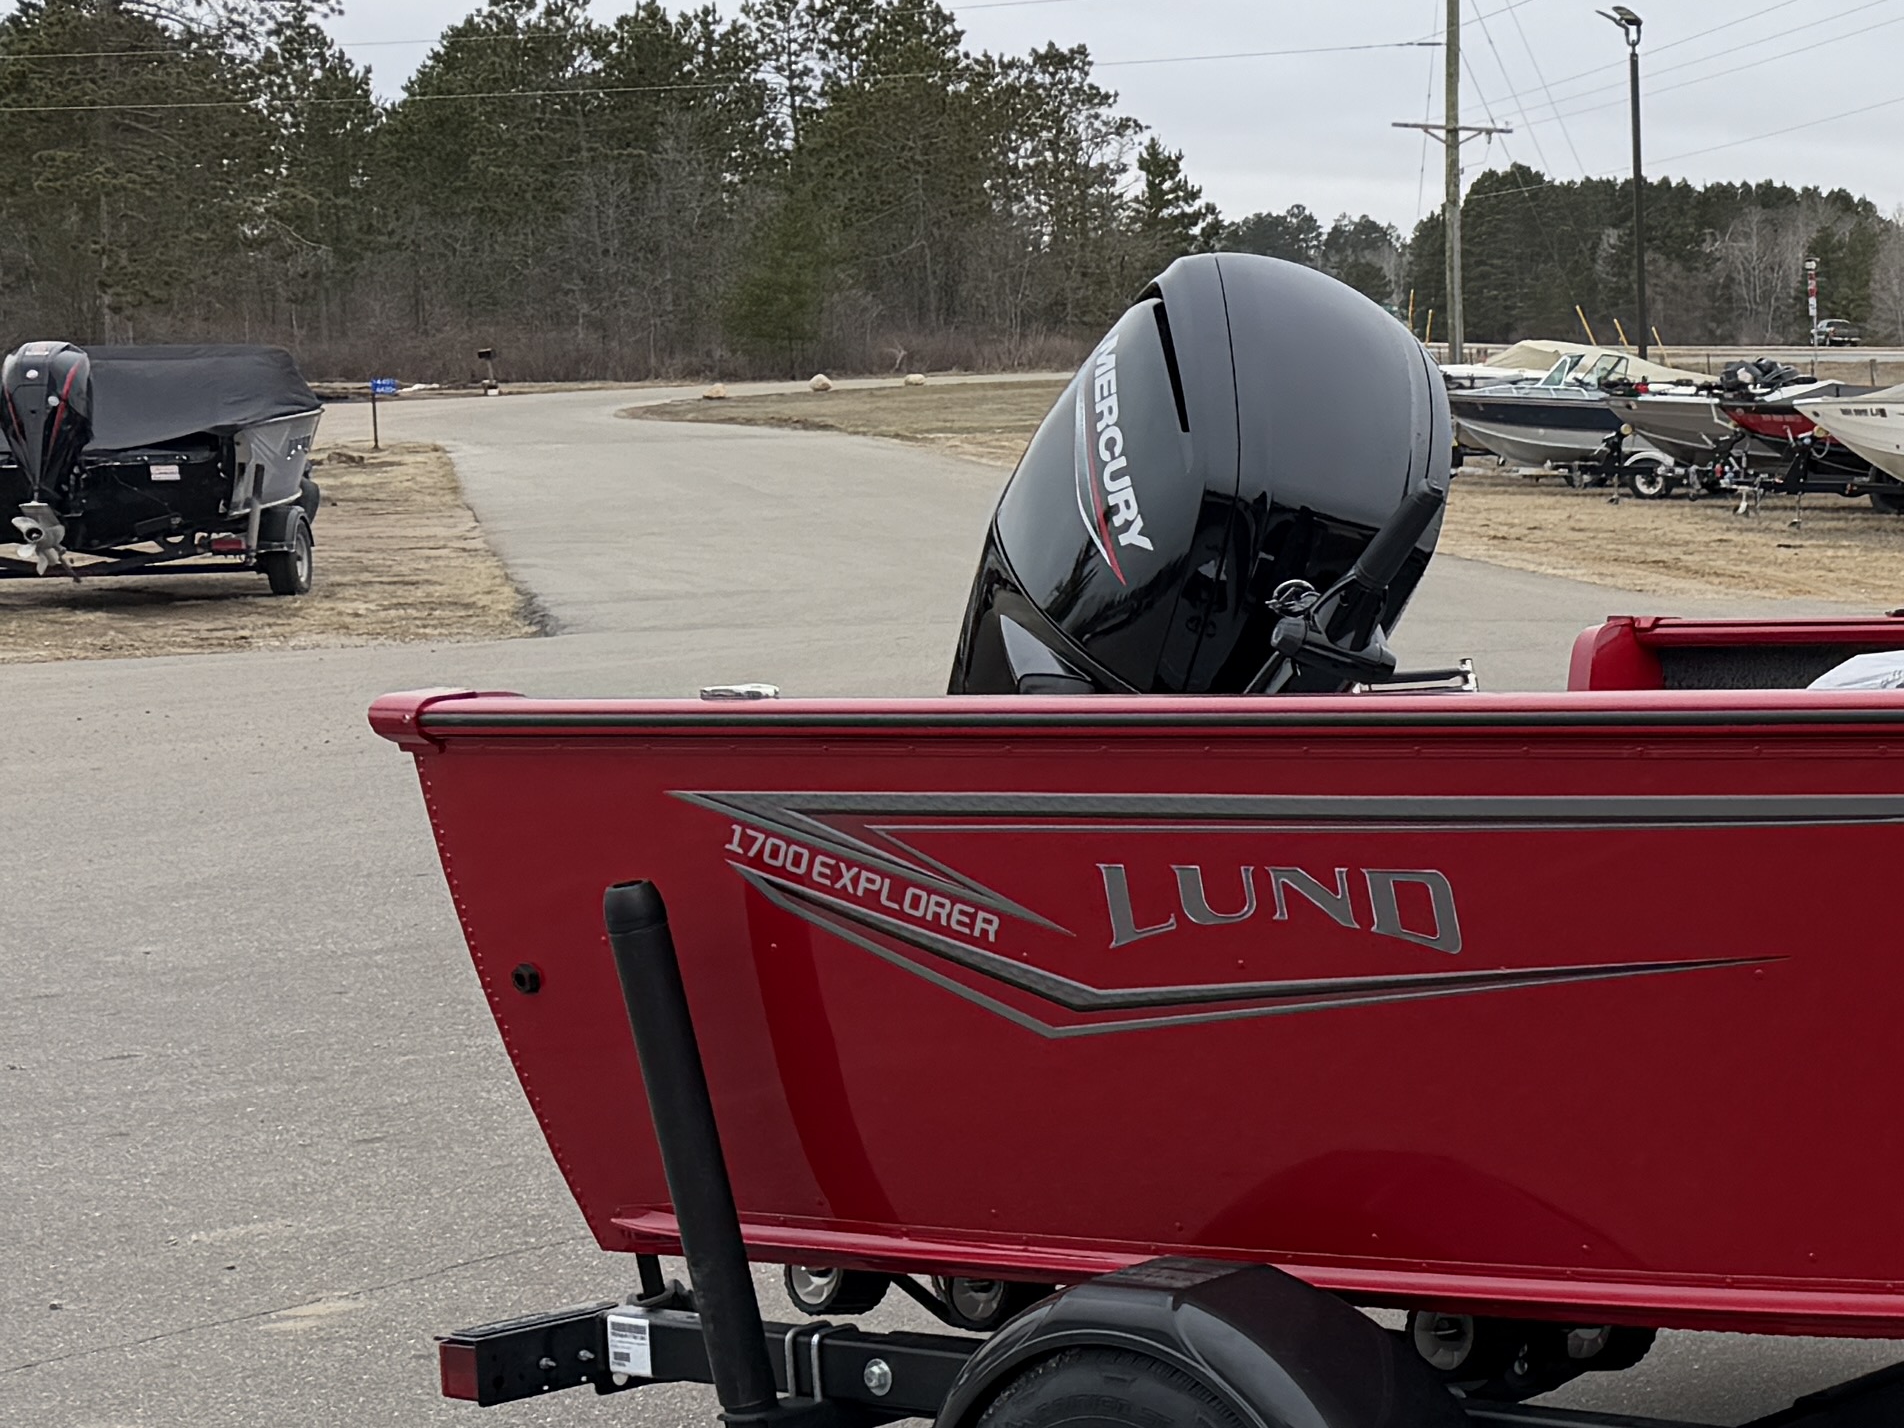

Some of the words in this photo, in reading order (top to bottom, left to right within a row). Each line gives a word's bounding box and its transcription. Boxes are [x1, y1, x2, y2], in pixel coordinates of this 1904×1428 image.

[1094, 333, 1155, 552] MERCURY
[724, 823, 810, 876] 1700
[811, 854, 1000, 943] EXPLORER
[1095, 862, 1463, 955] LUND
